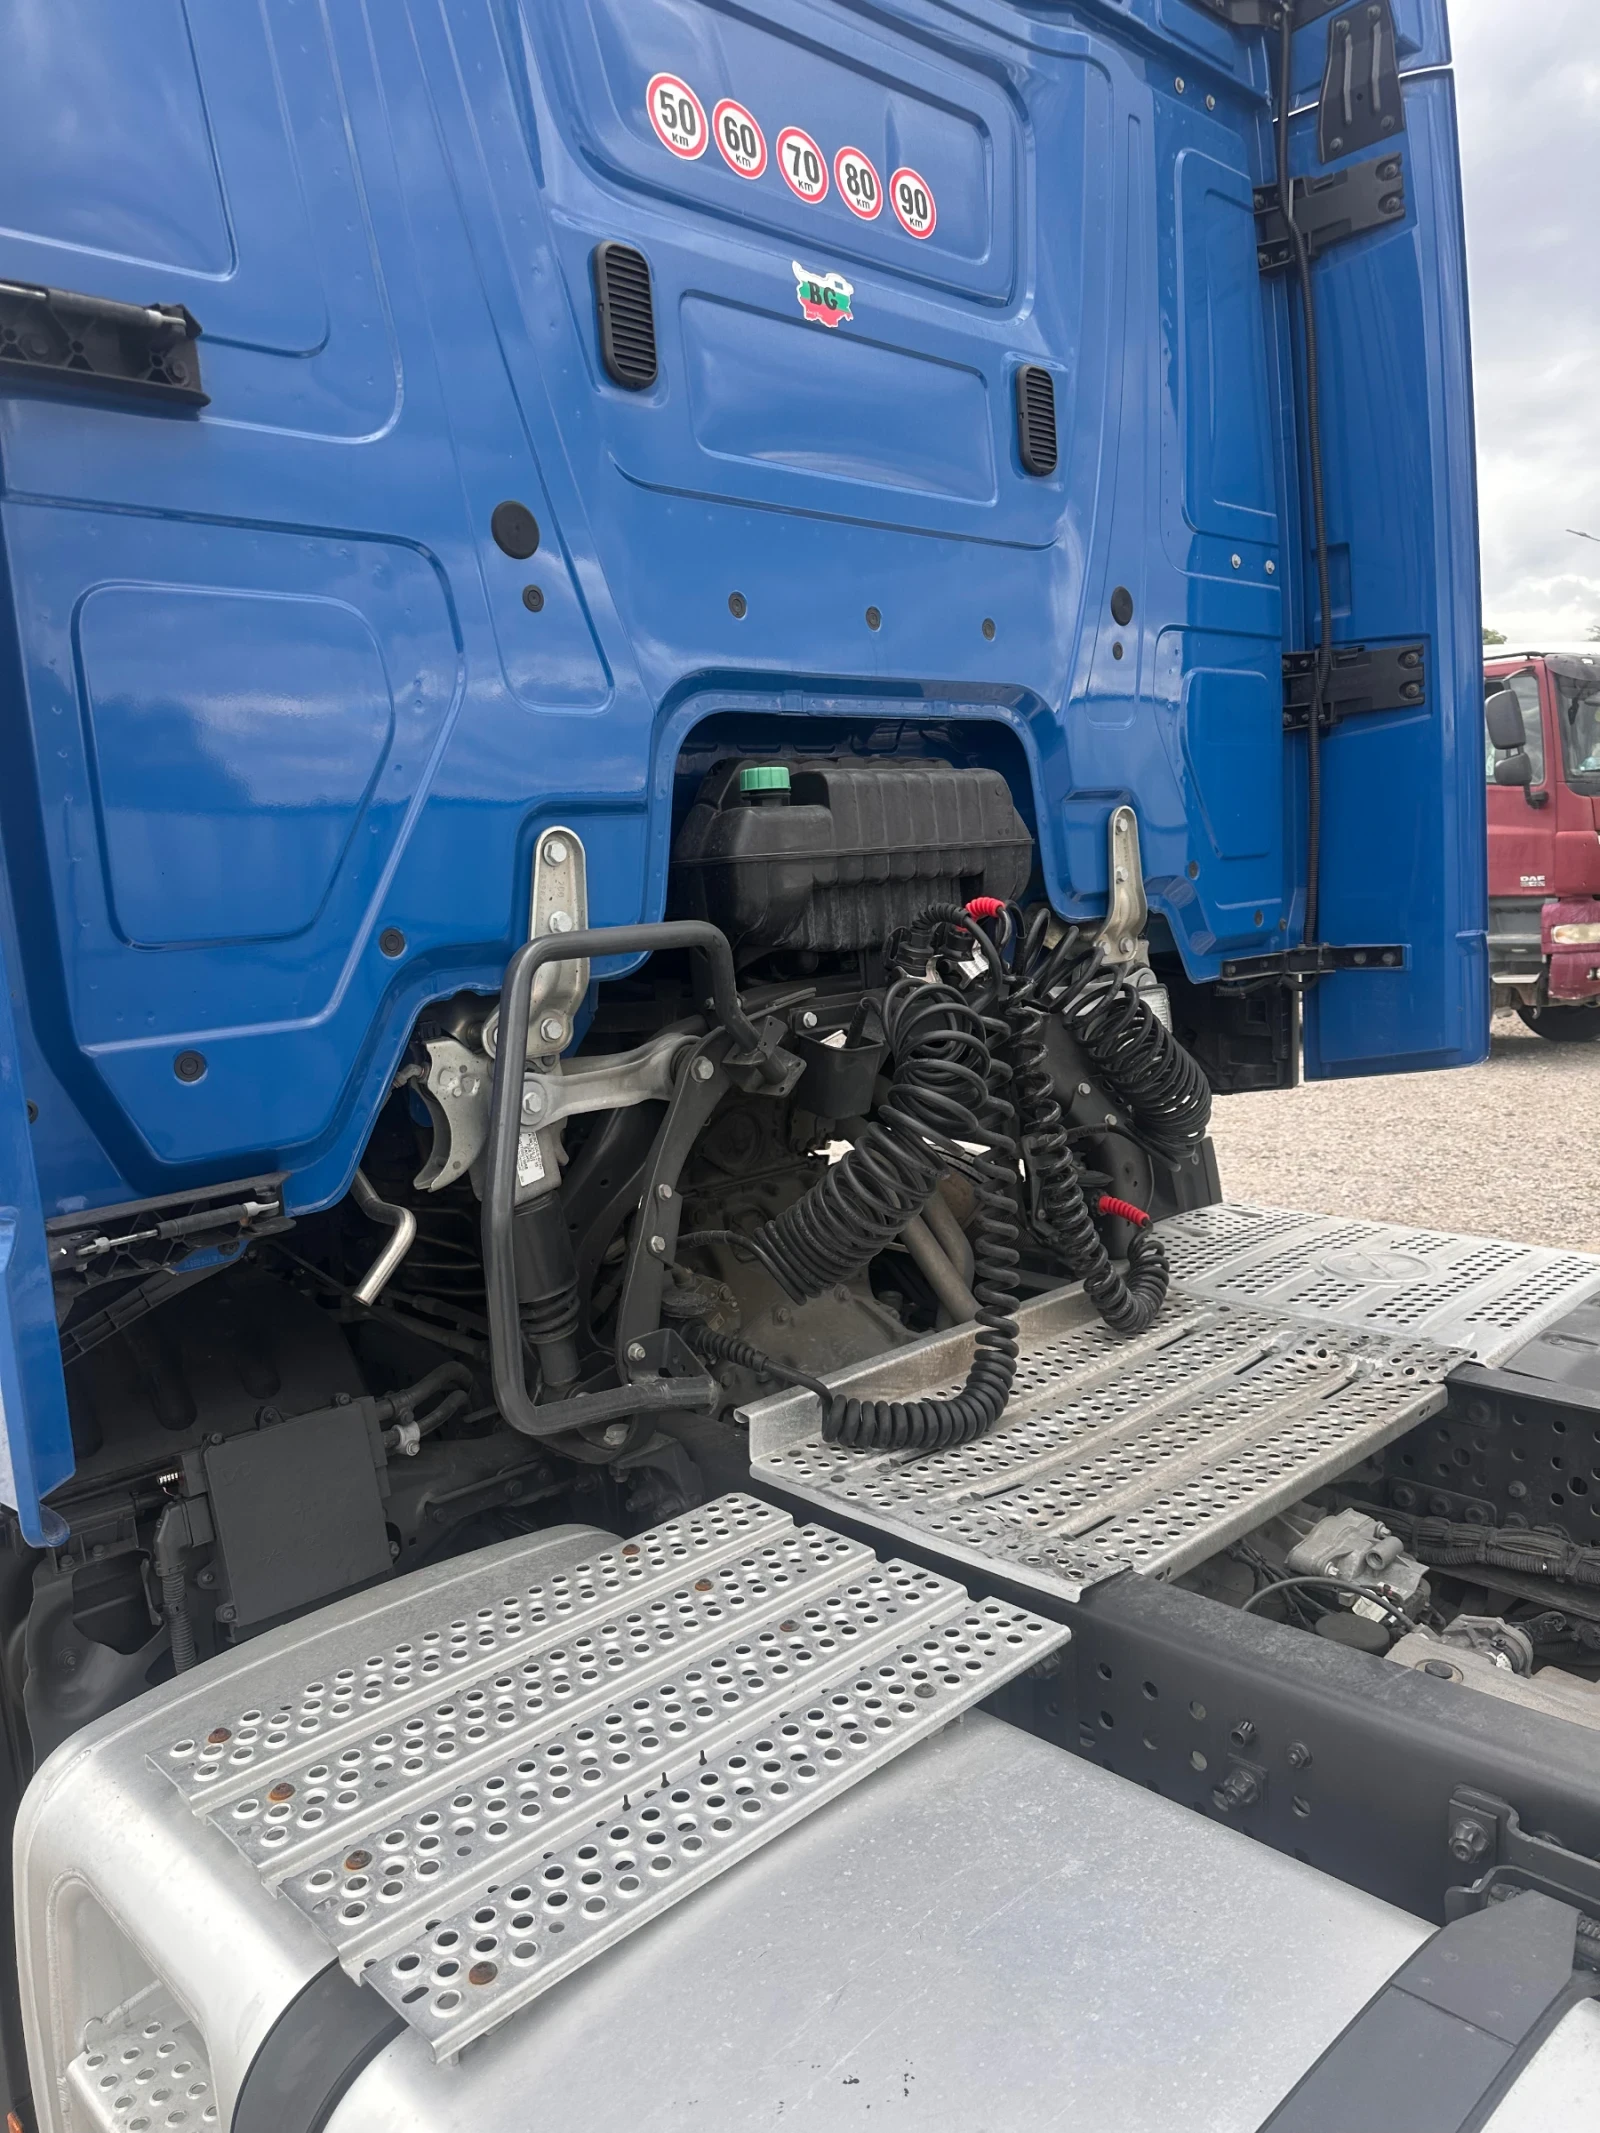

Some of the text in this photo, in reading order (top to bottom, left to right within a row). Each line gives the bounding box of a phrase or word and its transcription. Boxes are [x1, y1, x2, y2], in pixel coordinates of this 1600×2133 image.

[659, 89, 697, 136] 50
[724, 116, 757, 159] 60
[786, 142, 820, 184] 70
[845, 163, 875, 201] 80
[899, 183, 928, 220] 90
[808, 281, 838, 311] BG
